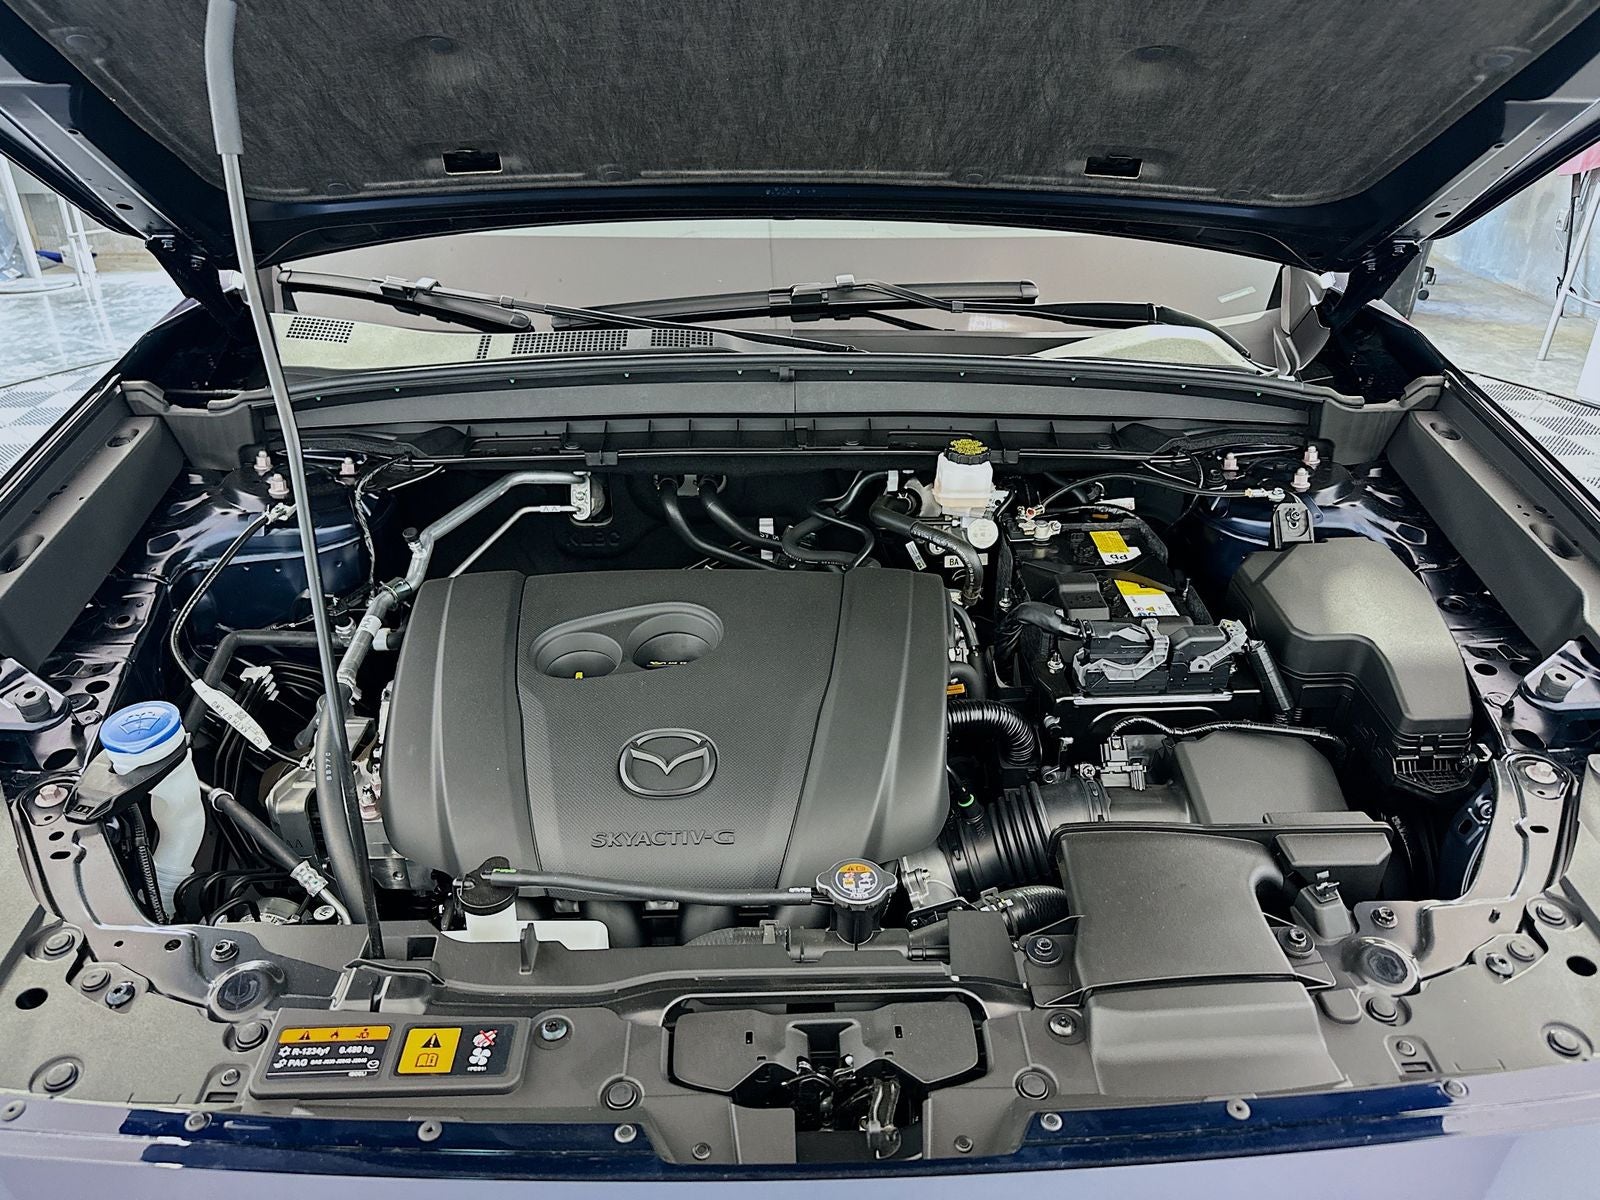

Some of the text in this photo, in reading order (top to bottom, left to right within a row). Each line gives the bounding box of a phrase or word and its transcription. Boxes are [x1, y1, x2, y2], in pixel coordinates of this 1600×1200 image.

[949, 558, 960, 566] BA
[590, 828, 736, 849] SKYACTIV-G
[362, 1045, 375, 1055] kg
[287, 1058, 309, 1068] PAG
